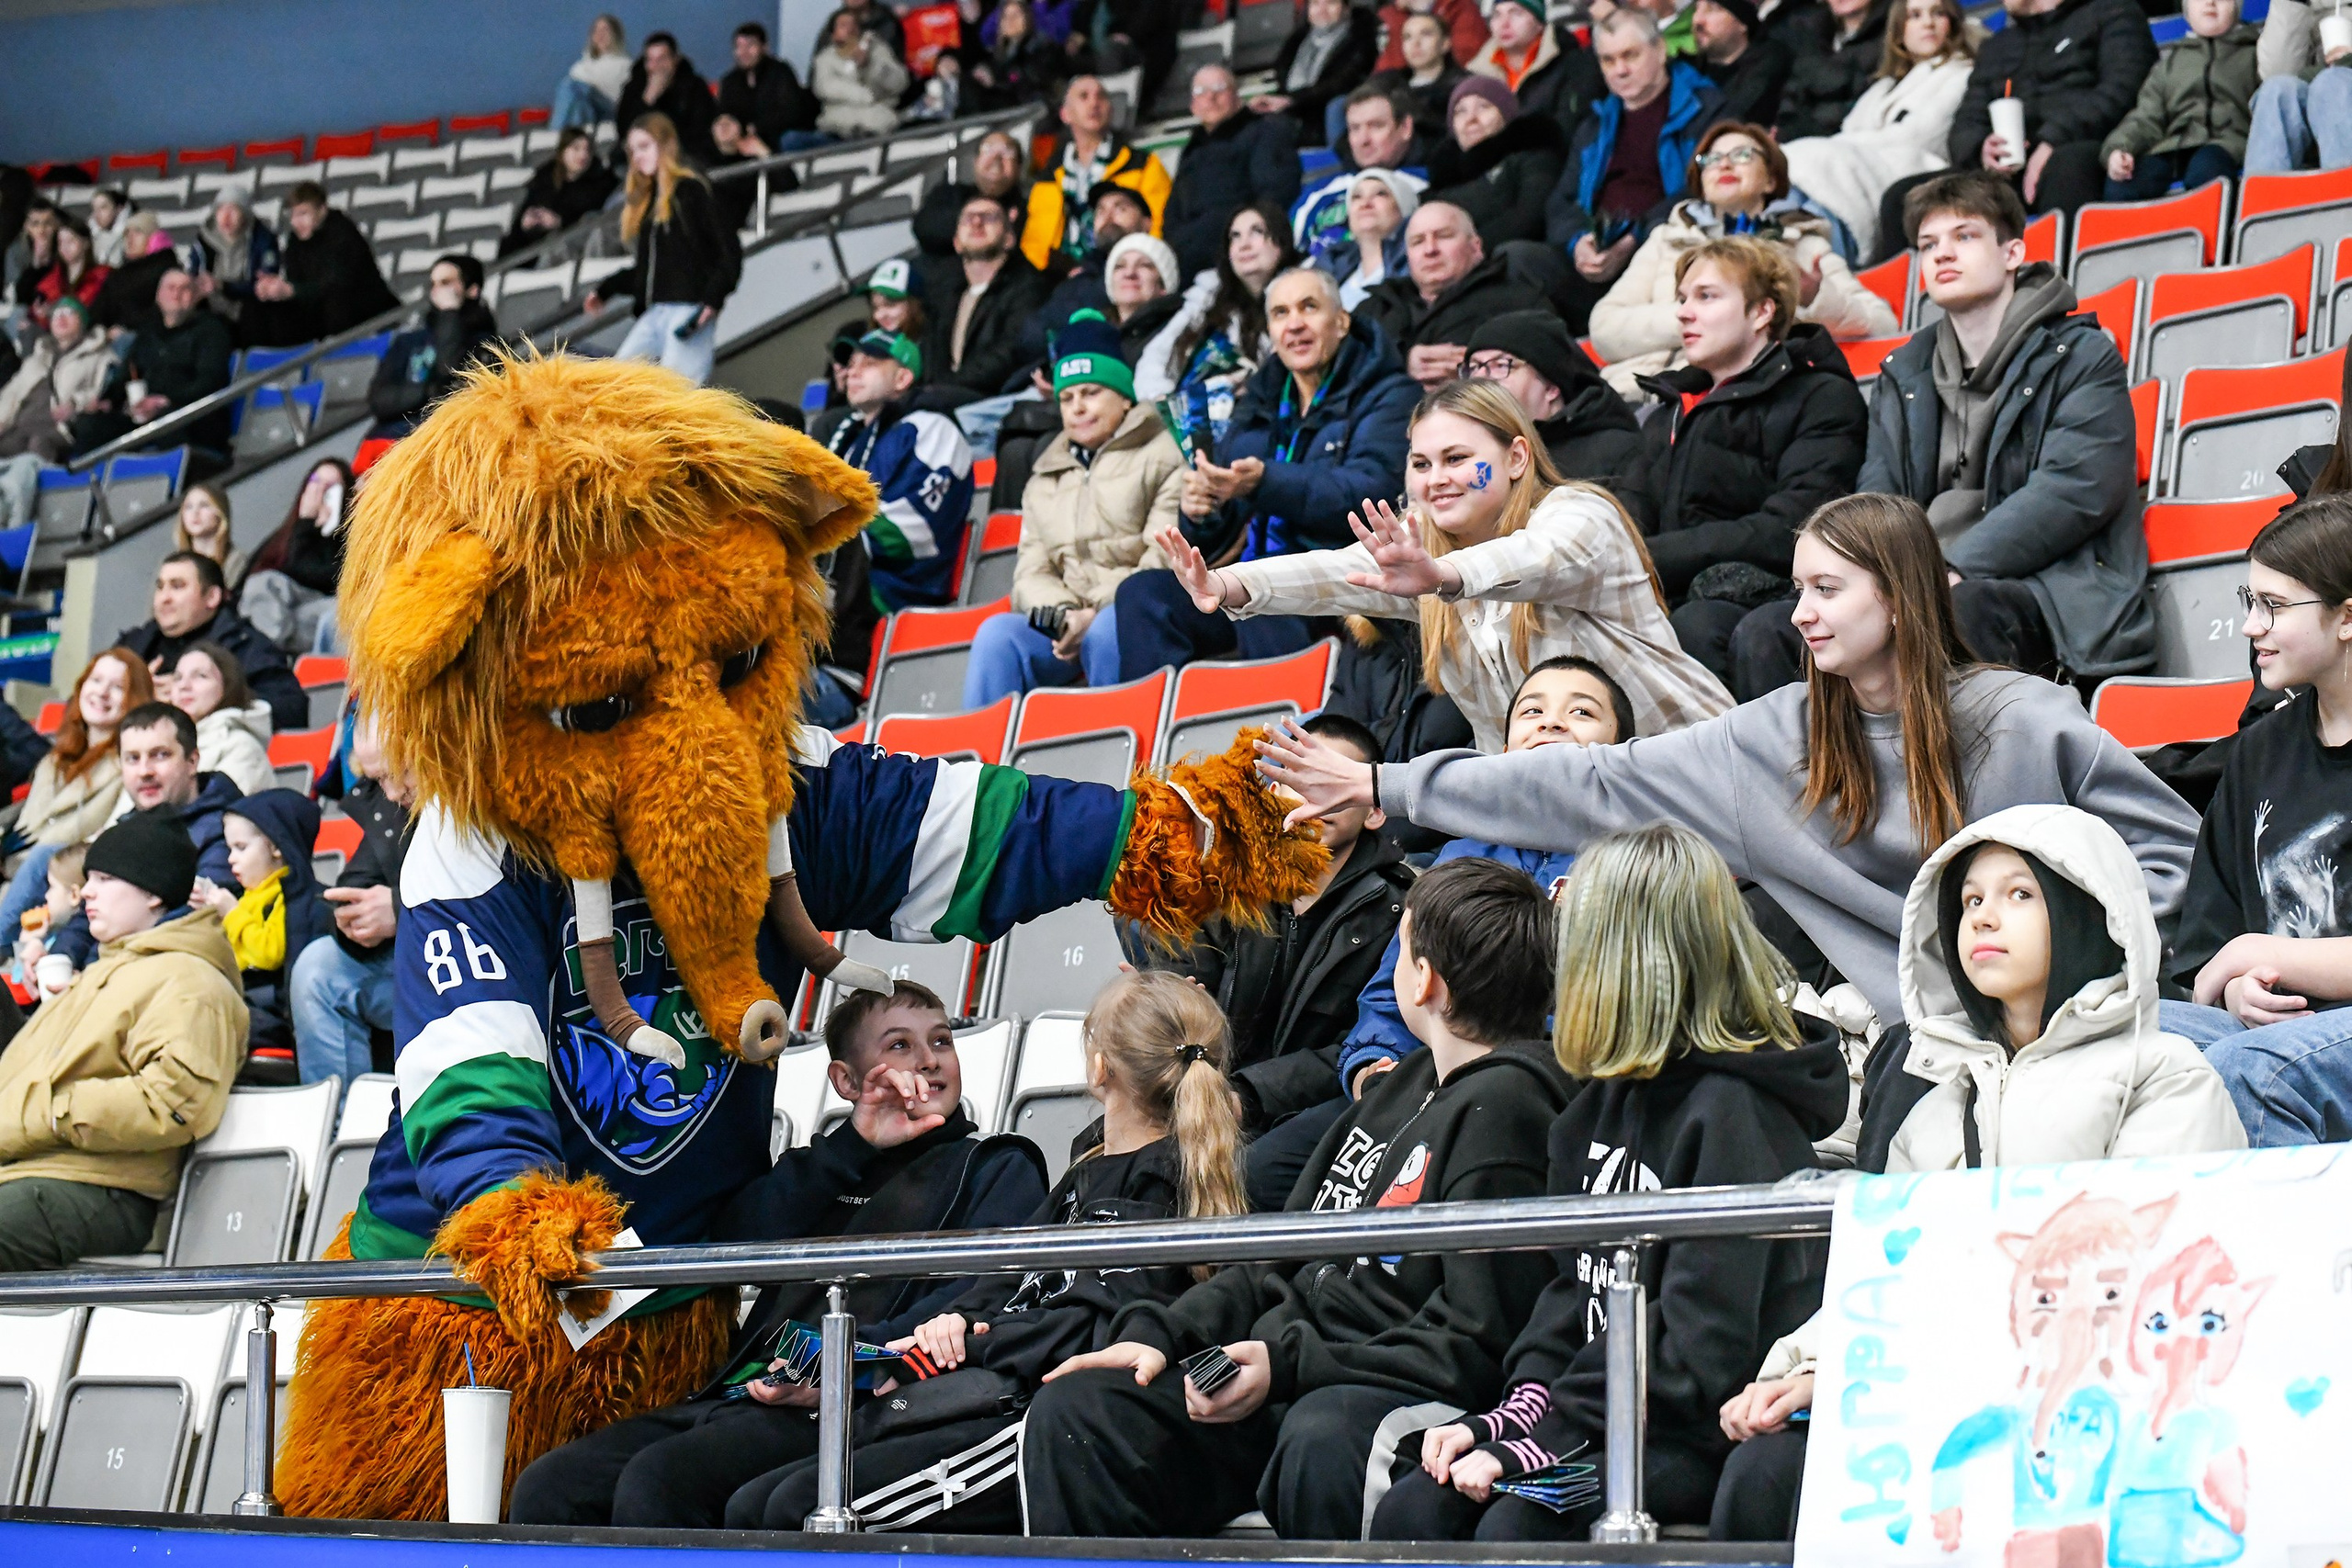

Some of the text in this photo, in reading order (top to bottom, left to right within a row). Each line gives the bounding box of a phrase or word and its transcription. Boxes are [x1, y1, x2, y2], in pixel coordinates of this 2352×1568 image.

[2240, 469, 2265, 491] 20
[2209, 617, 2235, 641] 21
[424, 921, 508, 997] 86
[1062, 945, 1084, 967] 16
[890, 964, 910, 980] 15
[226, 1211, 243, 1233] 13
[107, 1447, 126, 1470] 15
